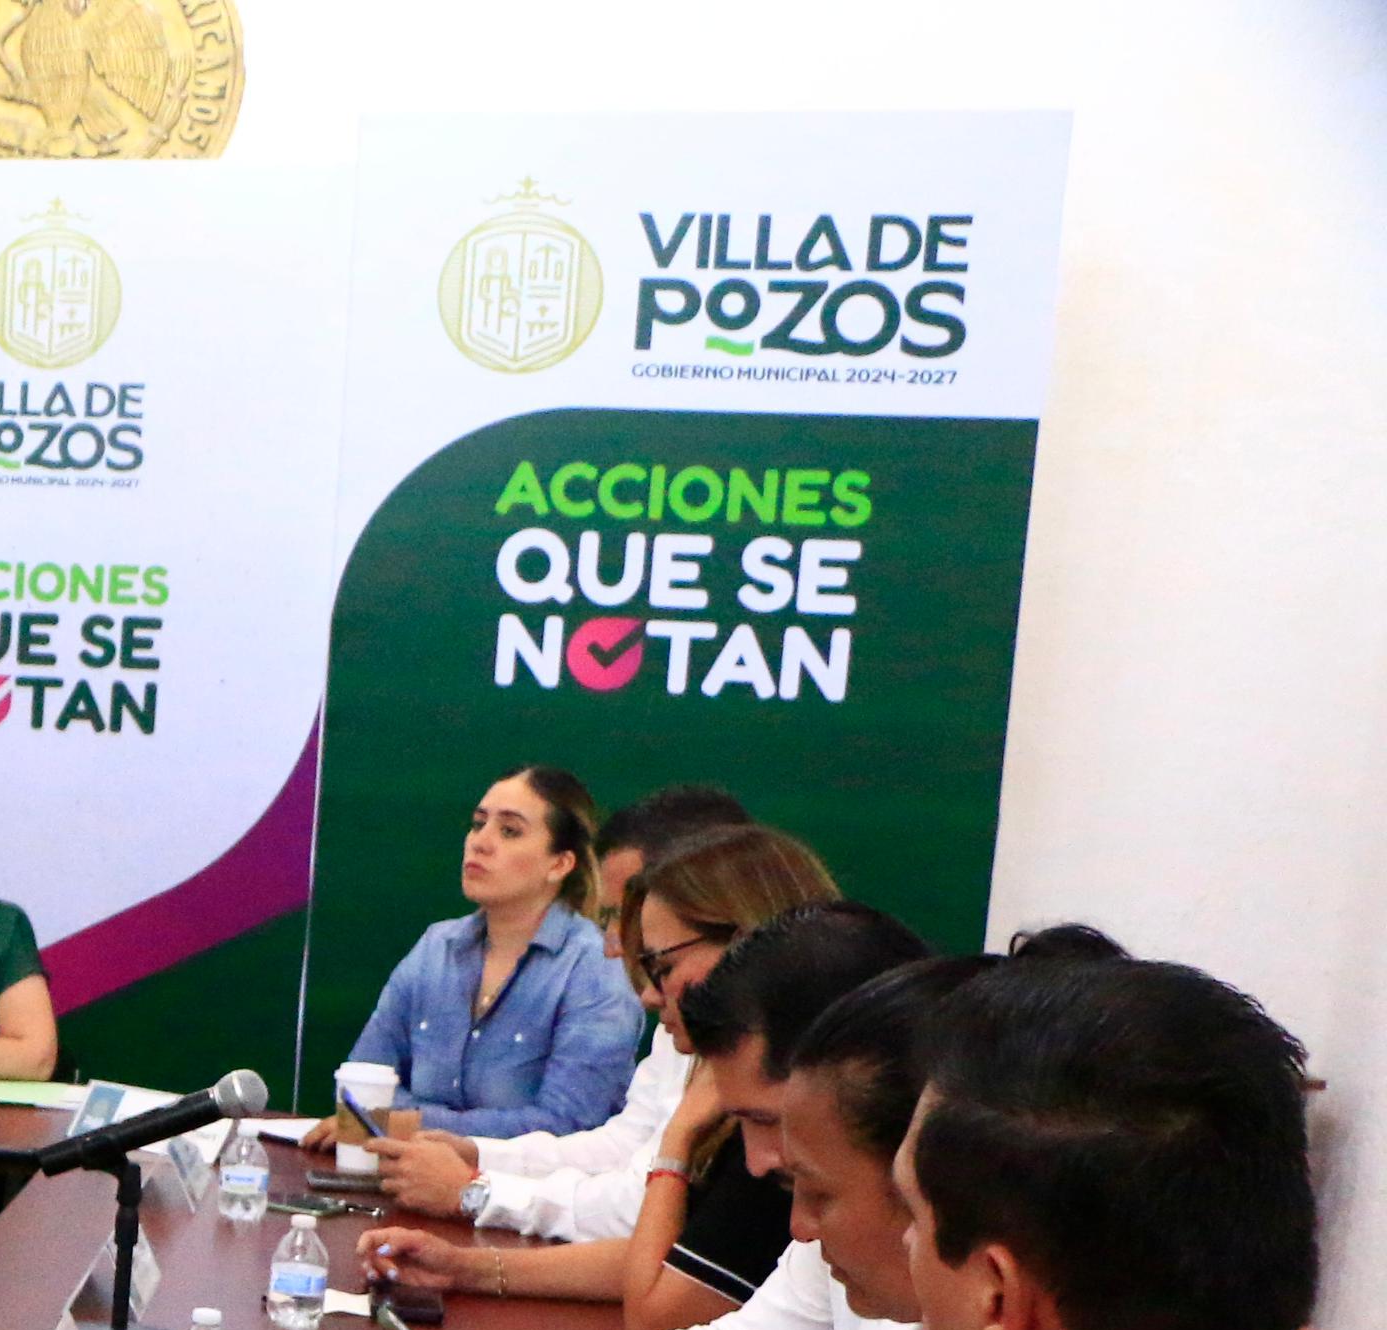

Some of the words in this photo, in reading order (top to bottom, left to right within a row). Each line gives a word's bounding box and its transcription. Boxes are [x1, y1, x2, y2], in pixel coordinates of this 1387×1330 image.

[638, 212, 852, 271] VILLA
[865, 214, 973, 273] DE
[633, 278, 967, 358] POZOS
[84, 383, 145, 419] DE
[631, 364, 734, 380] GOBIERNO
[736, 366, 841, 383] MUNICIPAL
[845, 367, 958, 385] 2024-2027
[494, 460, 873, 528] ACCIONES
[495, 527, 714, 610] QUE
[737, 535, 862, 617] SE
[79, 613, 163, 670] SE
[494, 613, 852, 703] NOTAN
